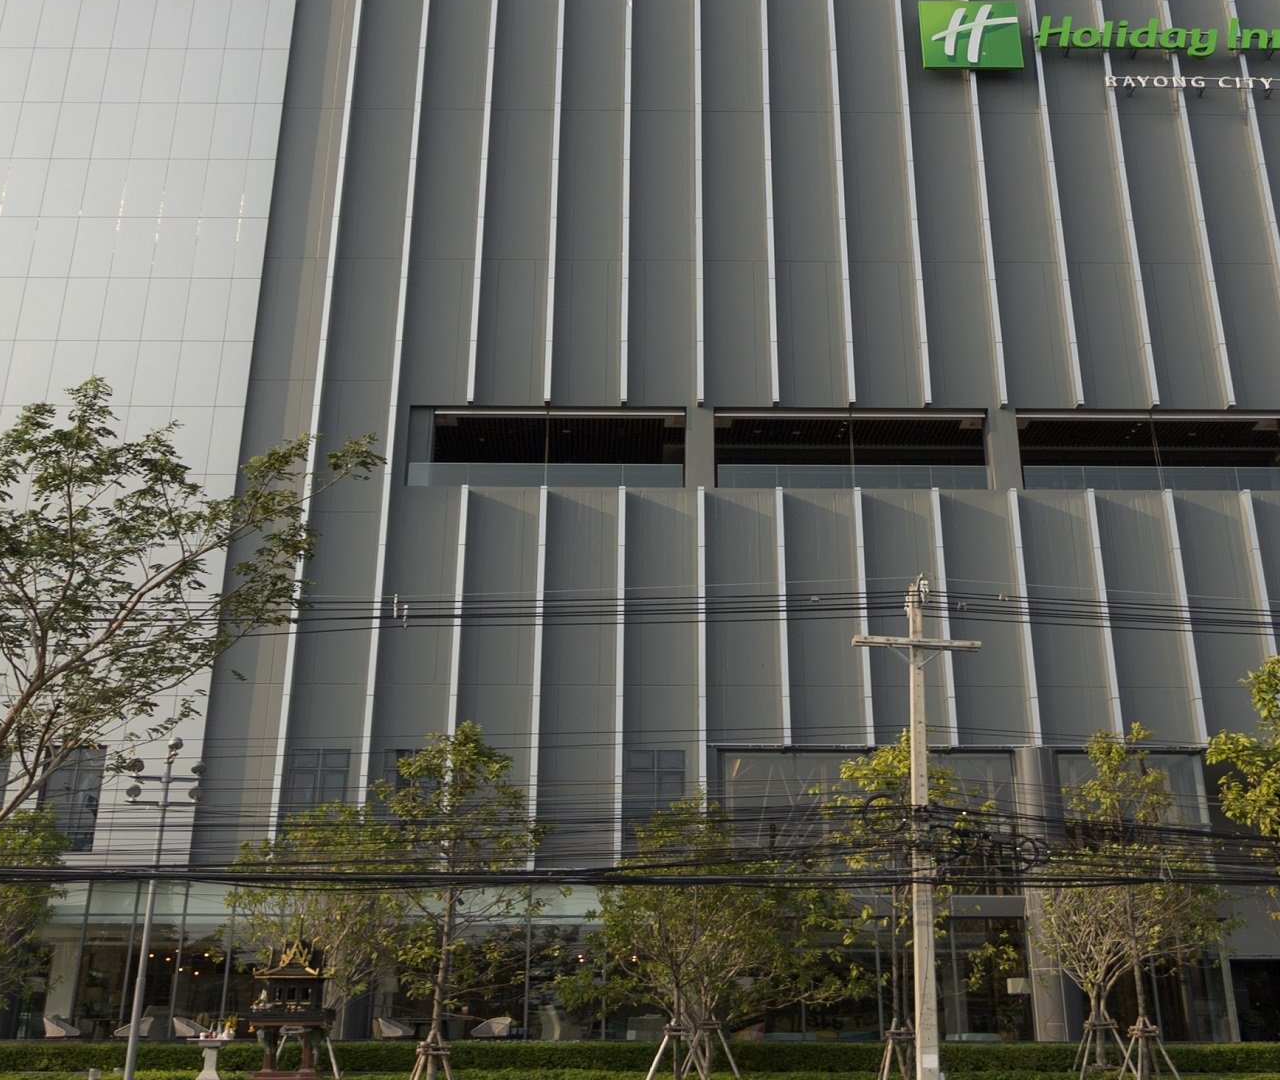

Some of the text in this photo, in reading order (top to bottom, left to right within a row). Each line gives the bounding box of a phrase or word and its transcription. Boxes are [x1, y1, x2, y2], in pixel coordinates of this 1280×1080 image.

[1034, 16, 1218, 57] Holiday
[1105, 75, 1206, 89] RAYONG
[1218, 76, 1273, 90] CITY
